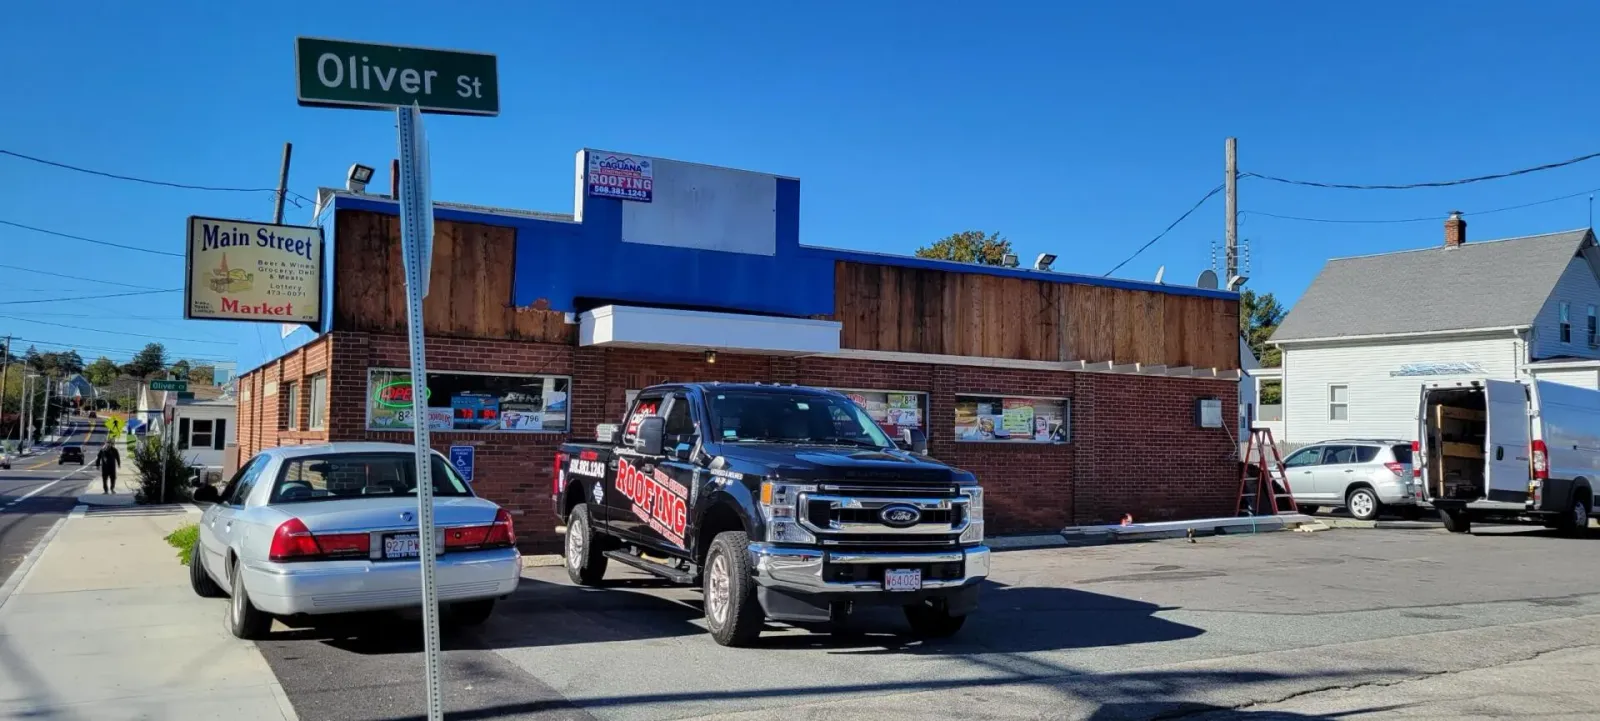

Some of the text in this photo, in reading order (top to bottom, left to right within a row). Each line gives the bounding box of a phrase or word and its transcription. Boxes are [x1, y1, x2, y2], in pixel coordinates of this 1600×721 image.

[317, 53, 482, 98] Oliver St
[599, 160, 642, 172] CAGUANA
[589, 174, 652, 190] ROOFING
[594, 186, 647, 198] 508.381.1243
[202, 224, 313, 260] Main Street
[270, 283, 302, 291] Lottery
[220, 296, 293, 316] Market
[152, 381, 175, 390] Oliver
[381, 386, 413, 401] OPE
[615, 456, 687, 539] ROOFING
[891, 510, 912, 520] Ford
[386, 540, 405, 552] 927
